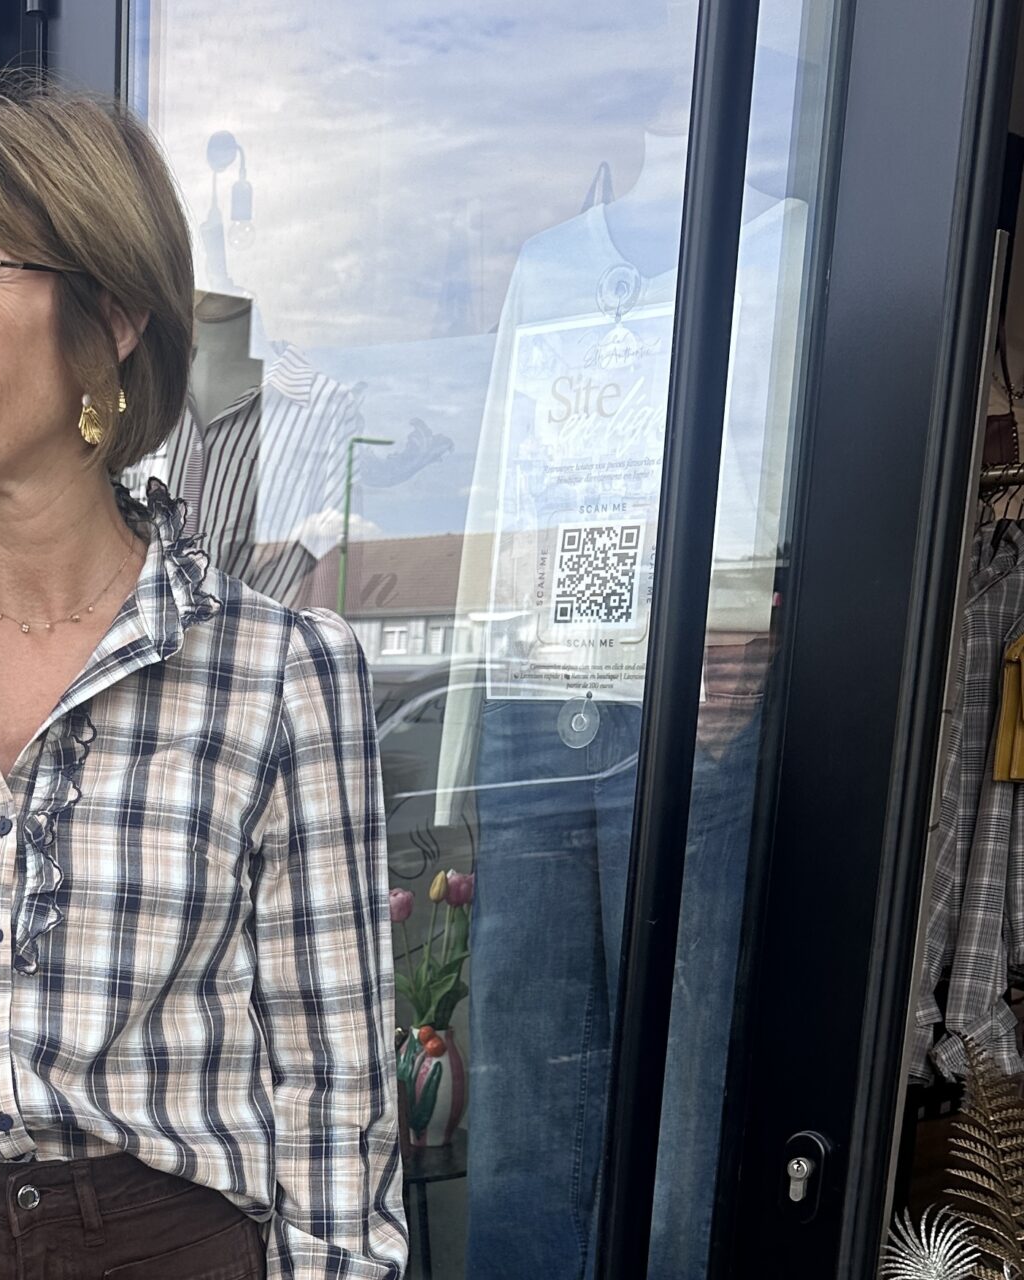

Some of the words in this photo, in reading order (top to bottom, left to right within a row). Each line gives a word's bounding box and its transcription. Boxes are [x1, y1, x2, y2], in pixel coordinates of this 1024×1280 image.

[548, 373, 621, 424] Site
[579, 505, 608, 514] SCAN
[611, 503, 627, 513] ME
[536, 572, 546, 606] SCAN
[541, 549, 549, 567] ME
[567, 639, 595, 648] SCAN
[599, 638, 614, 647] ME
